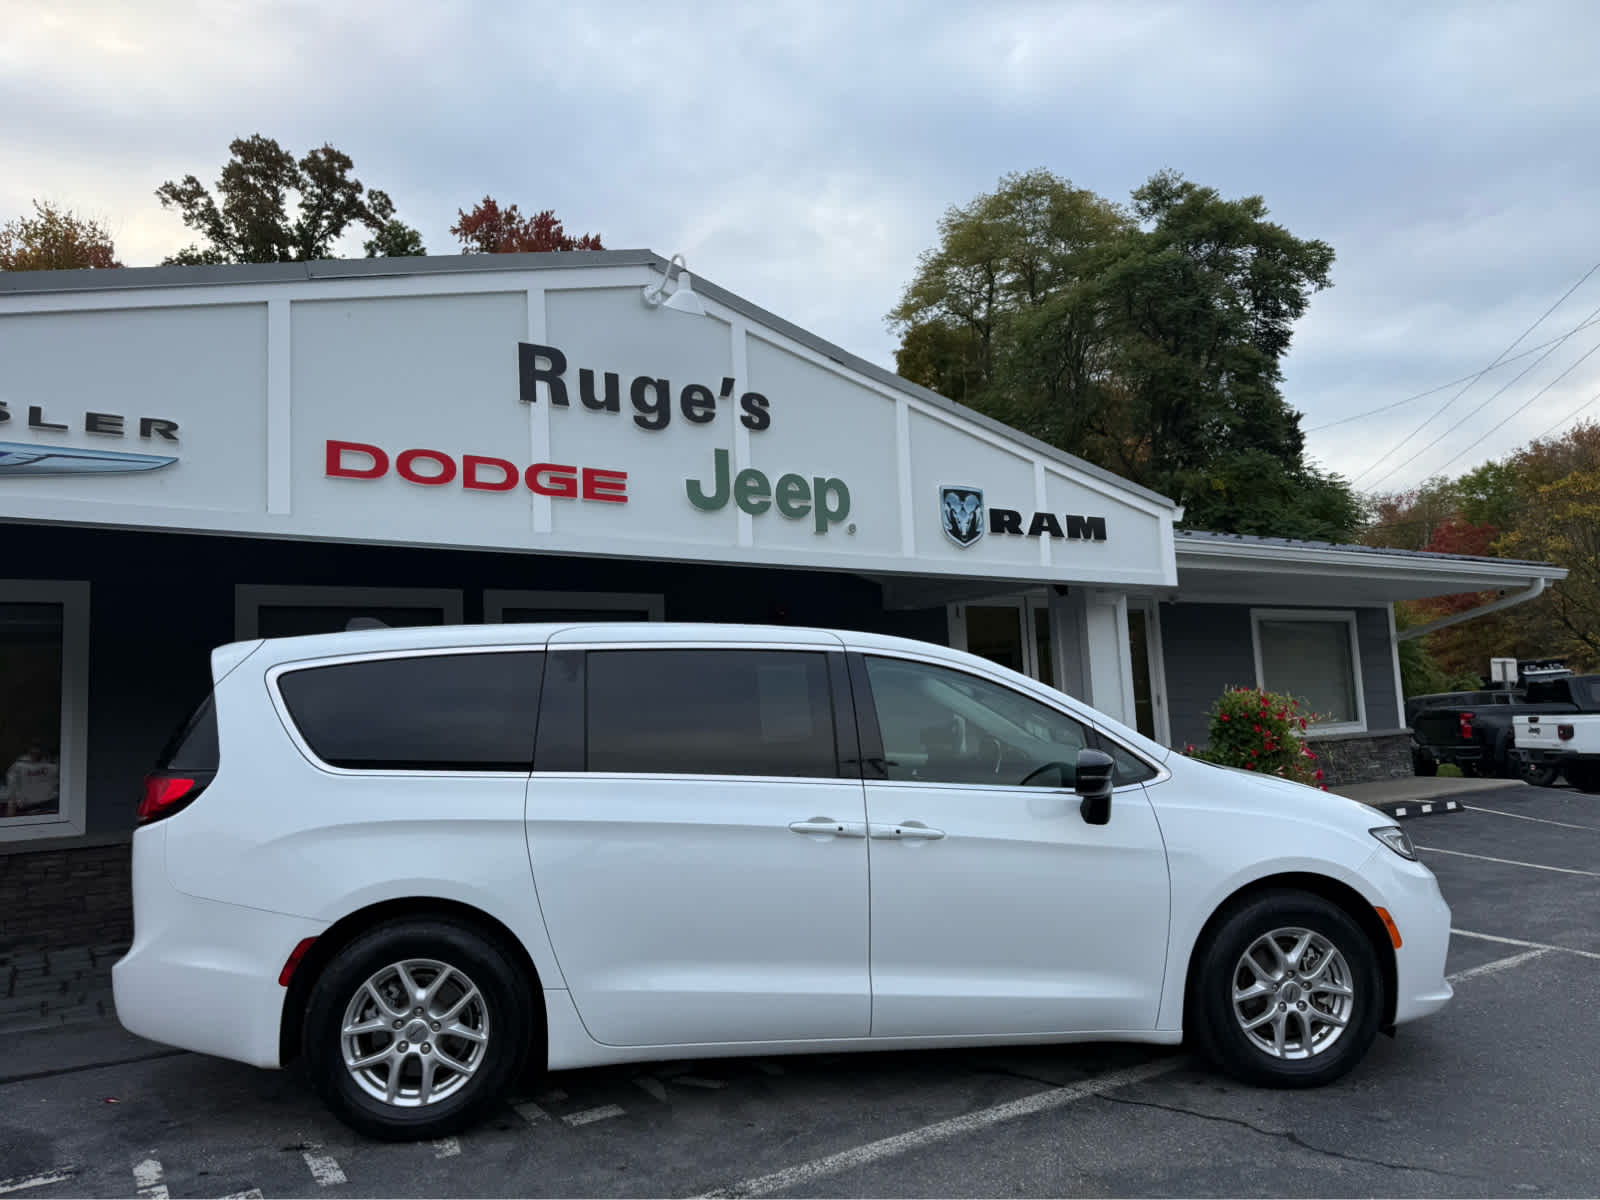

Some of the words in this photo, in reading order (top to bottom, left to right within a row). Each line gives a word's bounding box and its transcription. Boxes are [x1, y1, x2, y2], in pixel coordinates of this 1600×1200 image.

[518, 342, 771, 431] Ruge's
[325, 440, 628, 503] DODGE
[989, 508, 1107, 541] RAM
